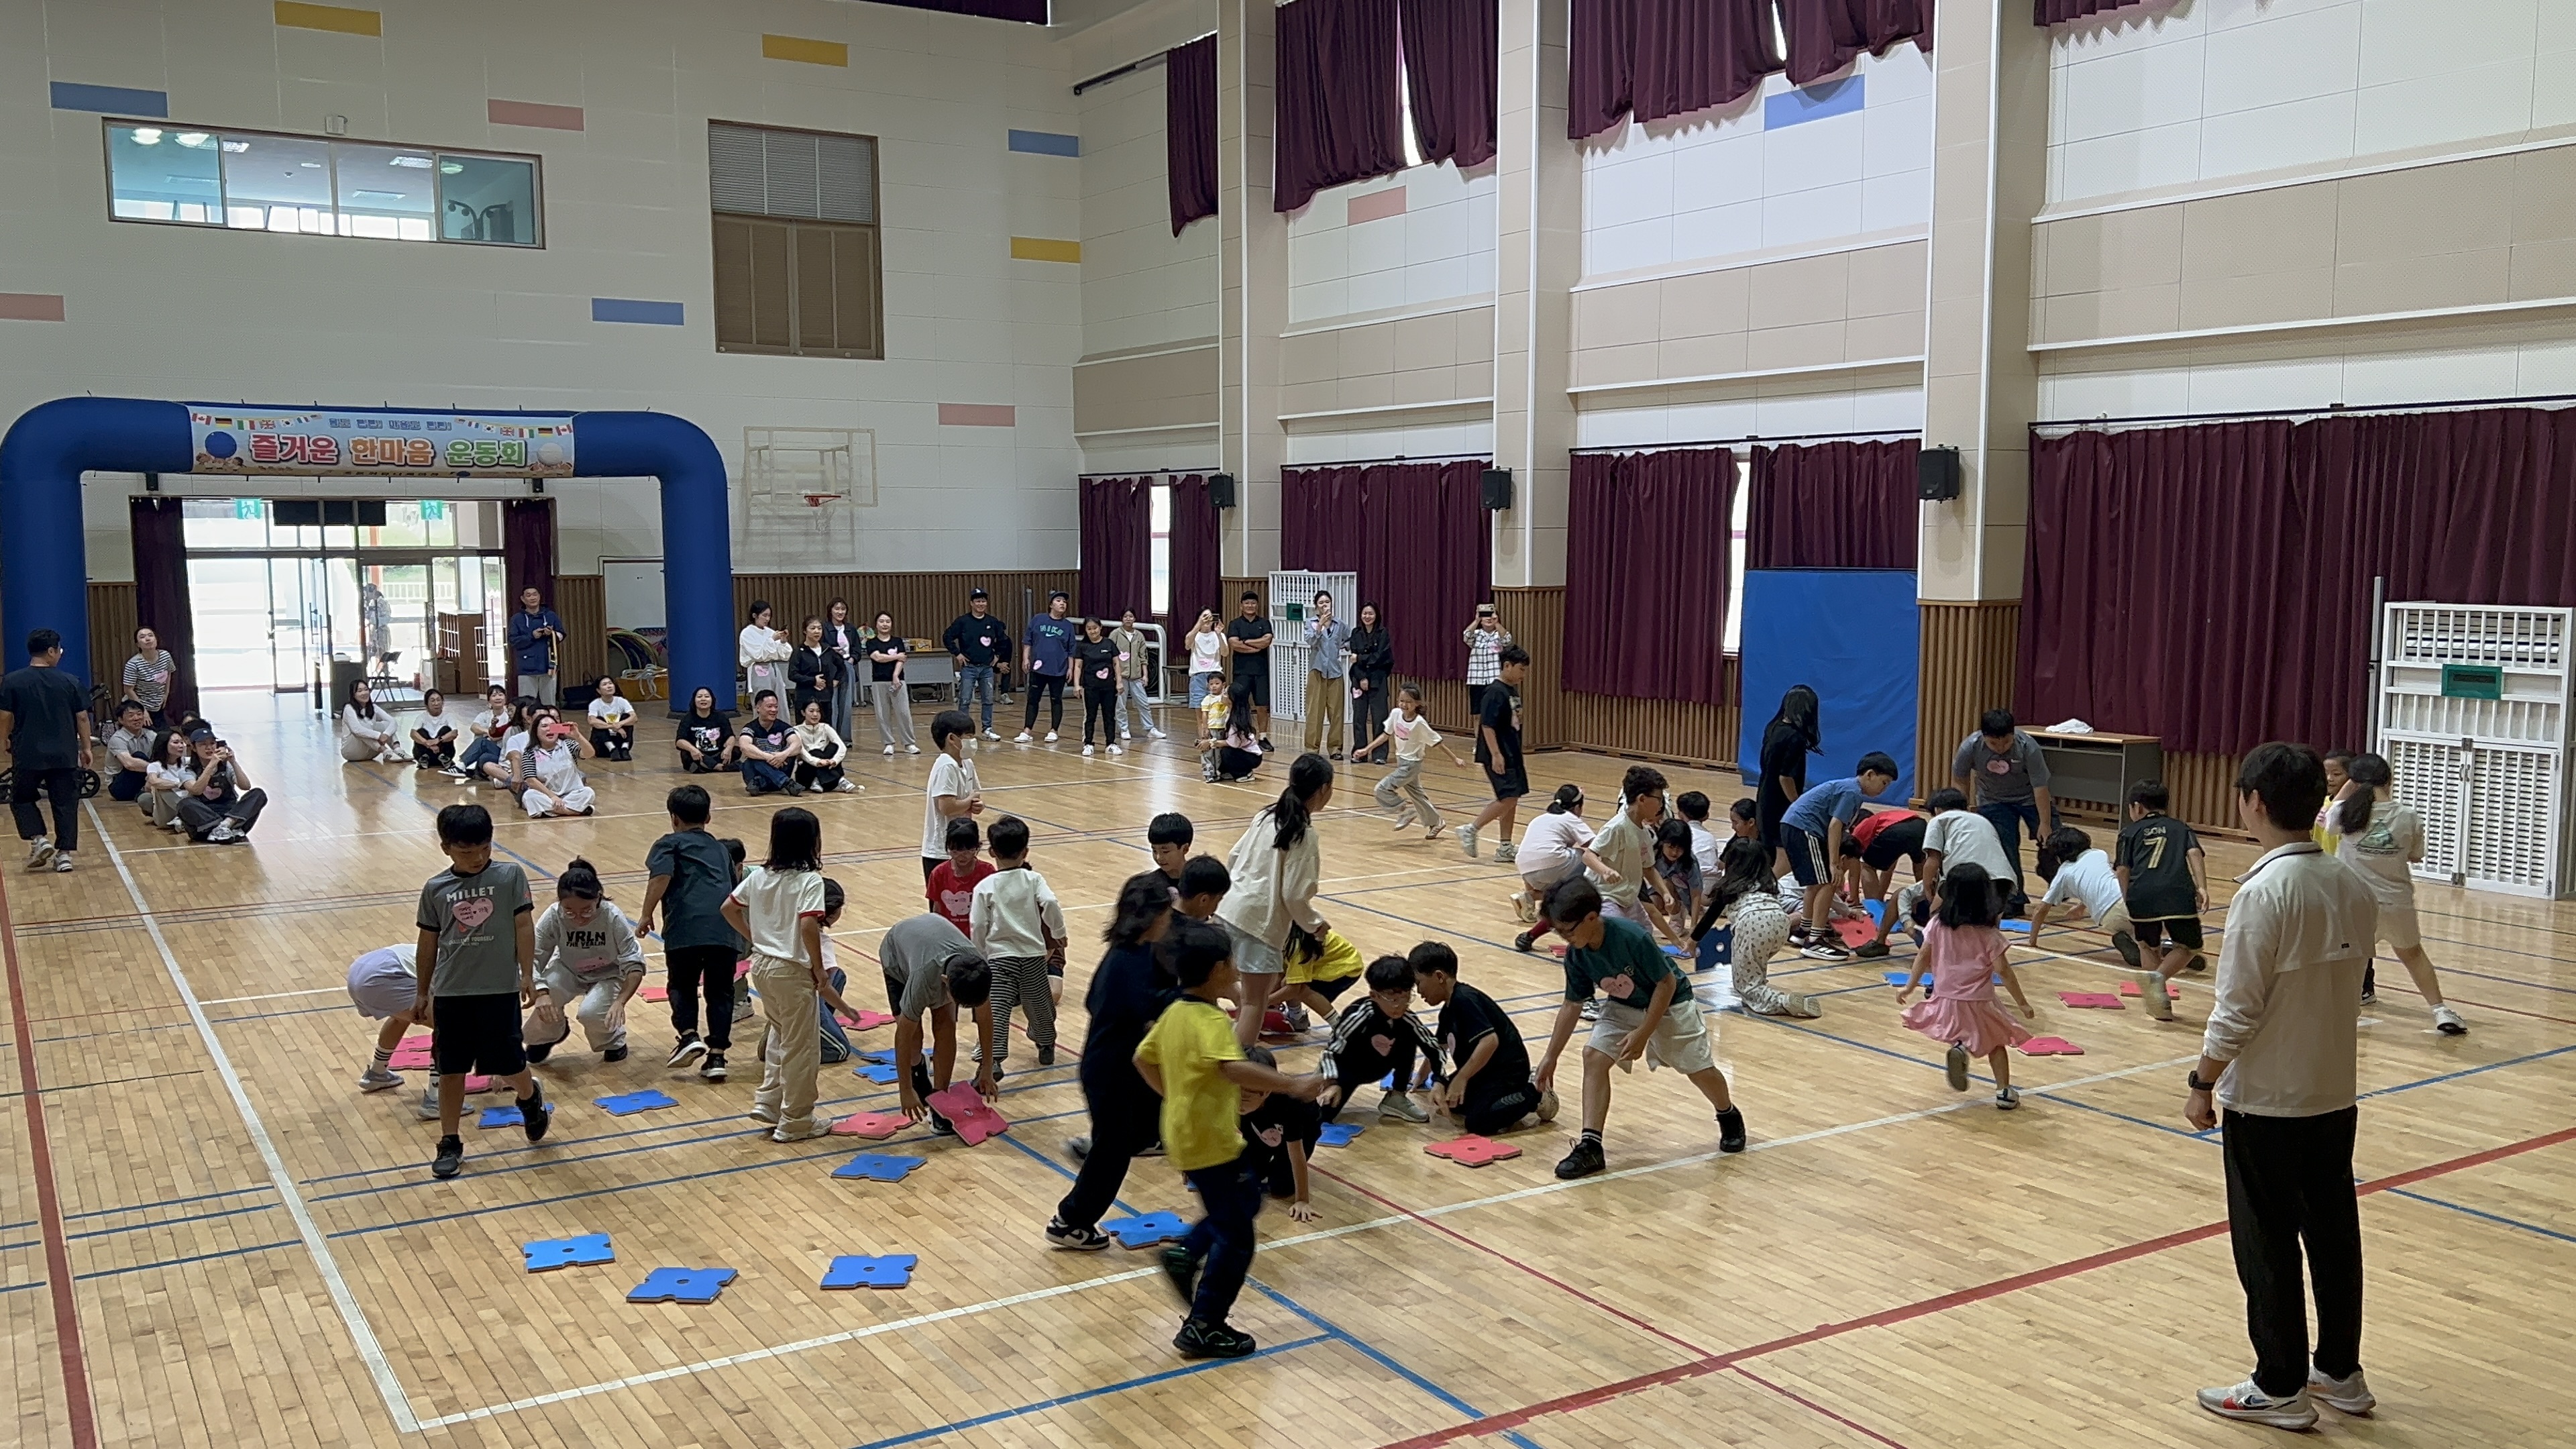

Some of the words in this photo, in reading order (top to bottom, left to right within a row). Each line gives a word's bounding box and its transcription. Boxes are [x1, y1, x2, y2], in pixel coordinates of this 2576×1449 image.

[251, 433, 337, 464] 즐거운
[350, 436, 434, 466] 한마음
[445, 439, 526, 466] 운동회
[2143, 837, 2167, 869] 7
[446, 885, 495, 903] MILLET
[566, 930, 606, 943] VRLN
